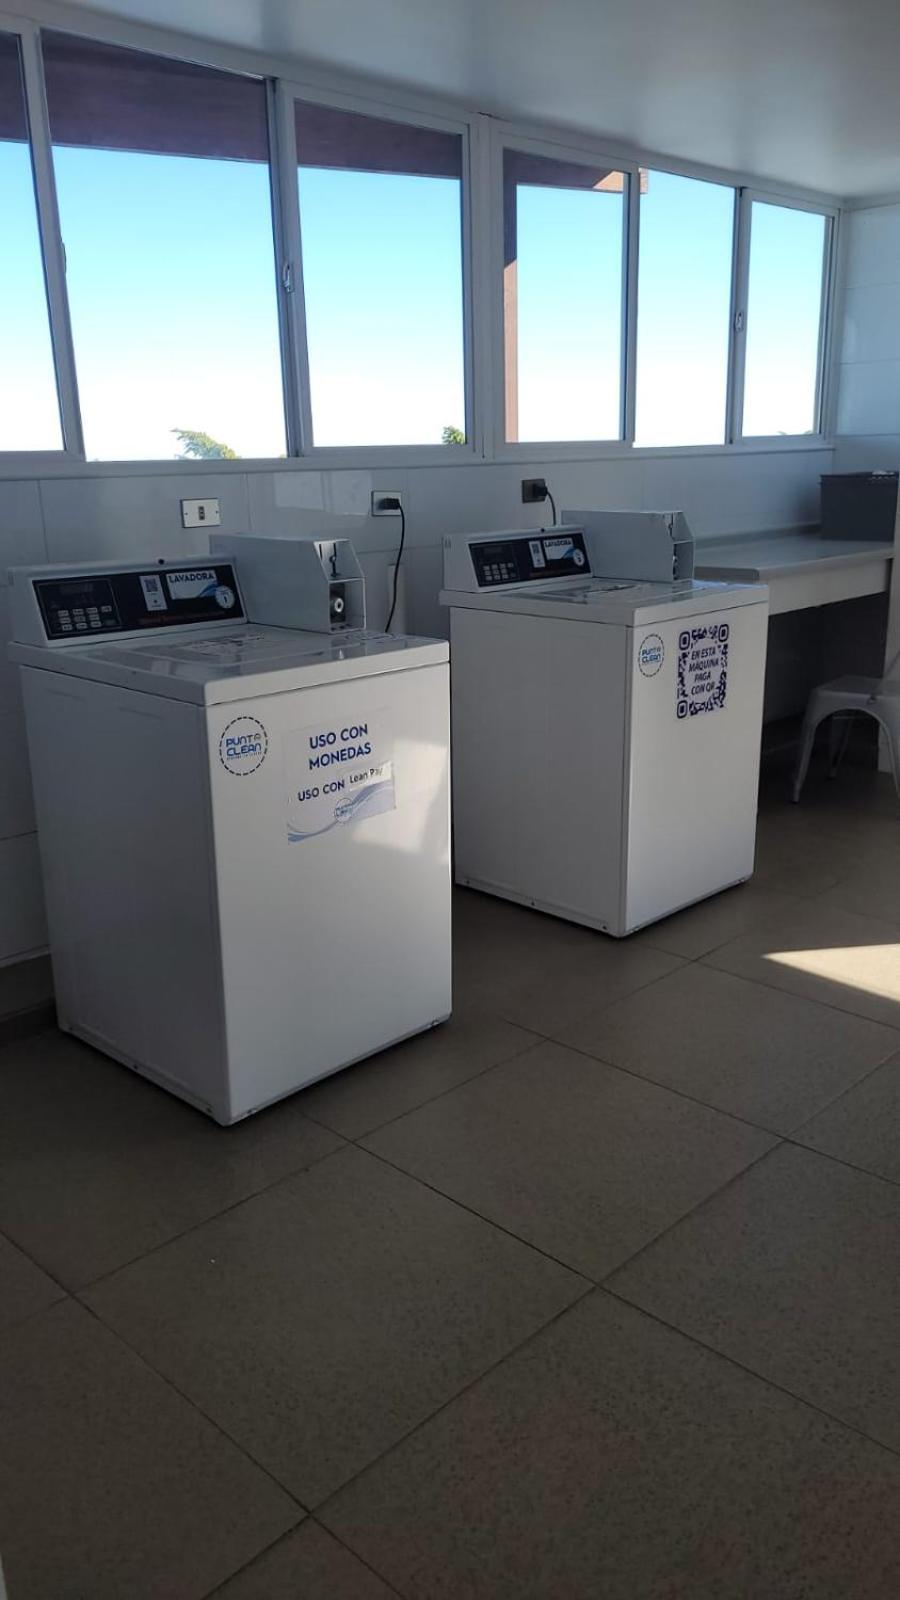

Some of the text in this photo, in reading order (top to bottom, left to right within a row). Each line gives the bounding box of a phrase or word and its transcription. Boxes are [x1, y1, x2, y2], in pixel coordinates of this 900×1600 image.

[168, 572, 214, 583] LAVADORA
[641, 654, 661, 664] CLEAN
[691, 647, 716, 660] EN ESTA
[694, 671, 711, 682] PAGA
[691, 684, 705, 695] CON
[309, 723, 368, 749] USO CON
[226, 743, 262, 756] CLEAN
[308, 742, 372, 770] MONEDAS
[297, 787, 320, 801] USO
[322, 779, 345, 795] CON
